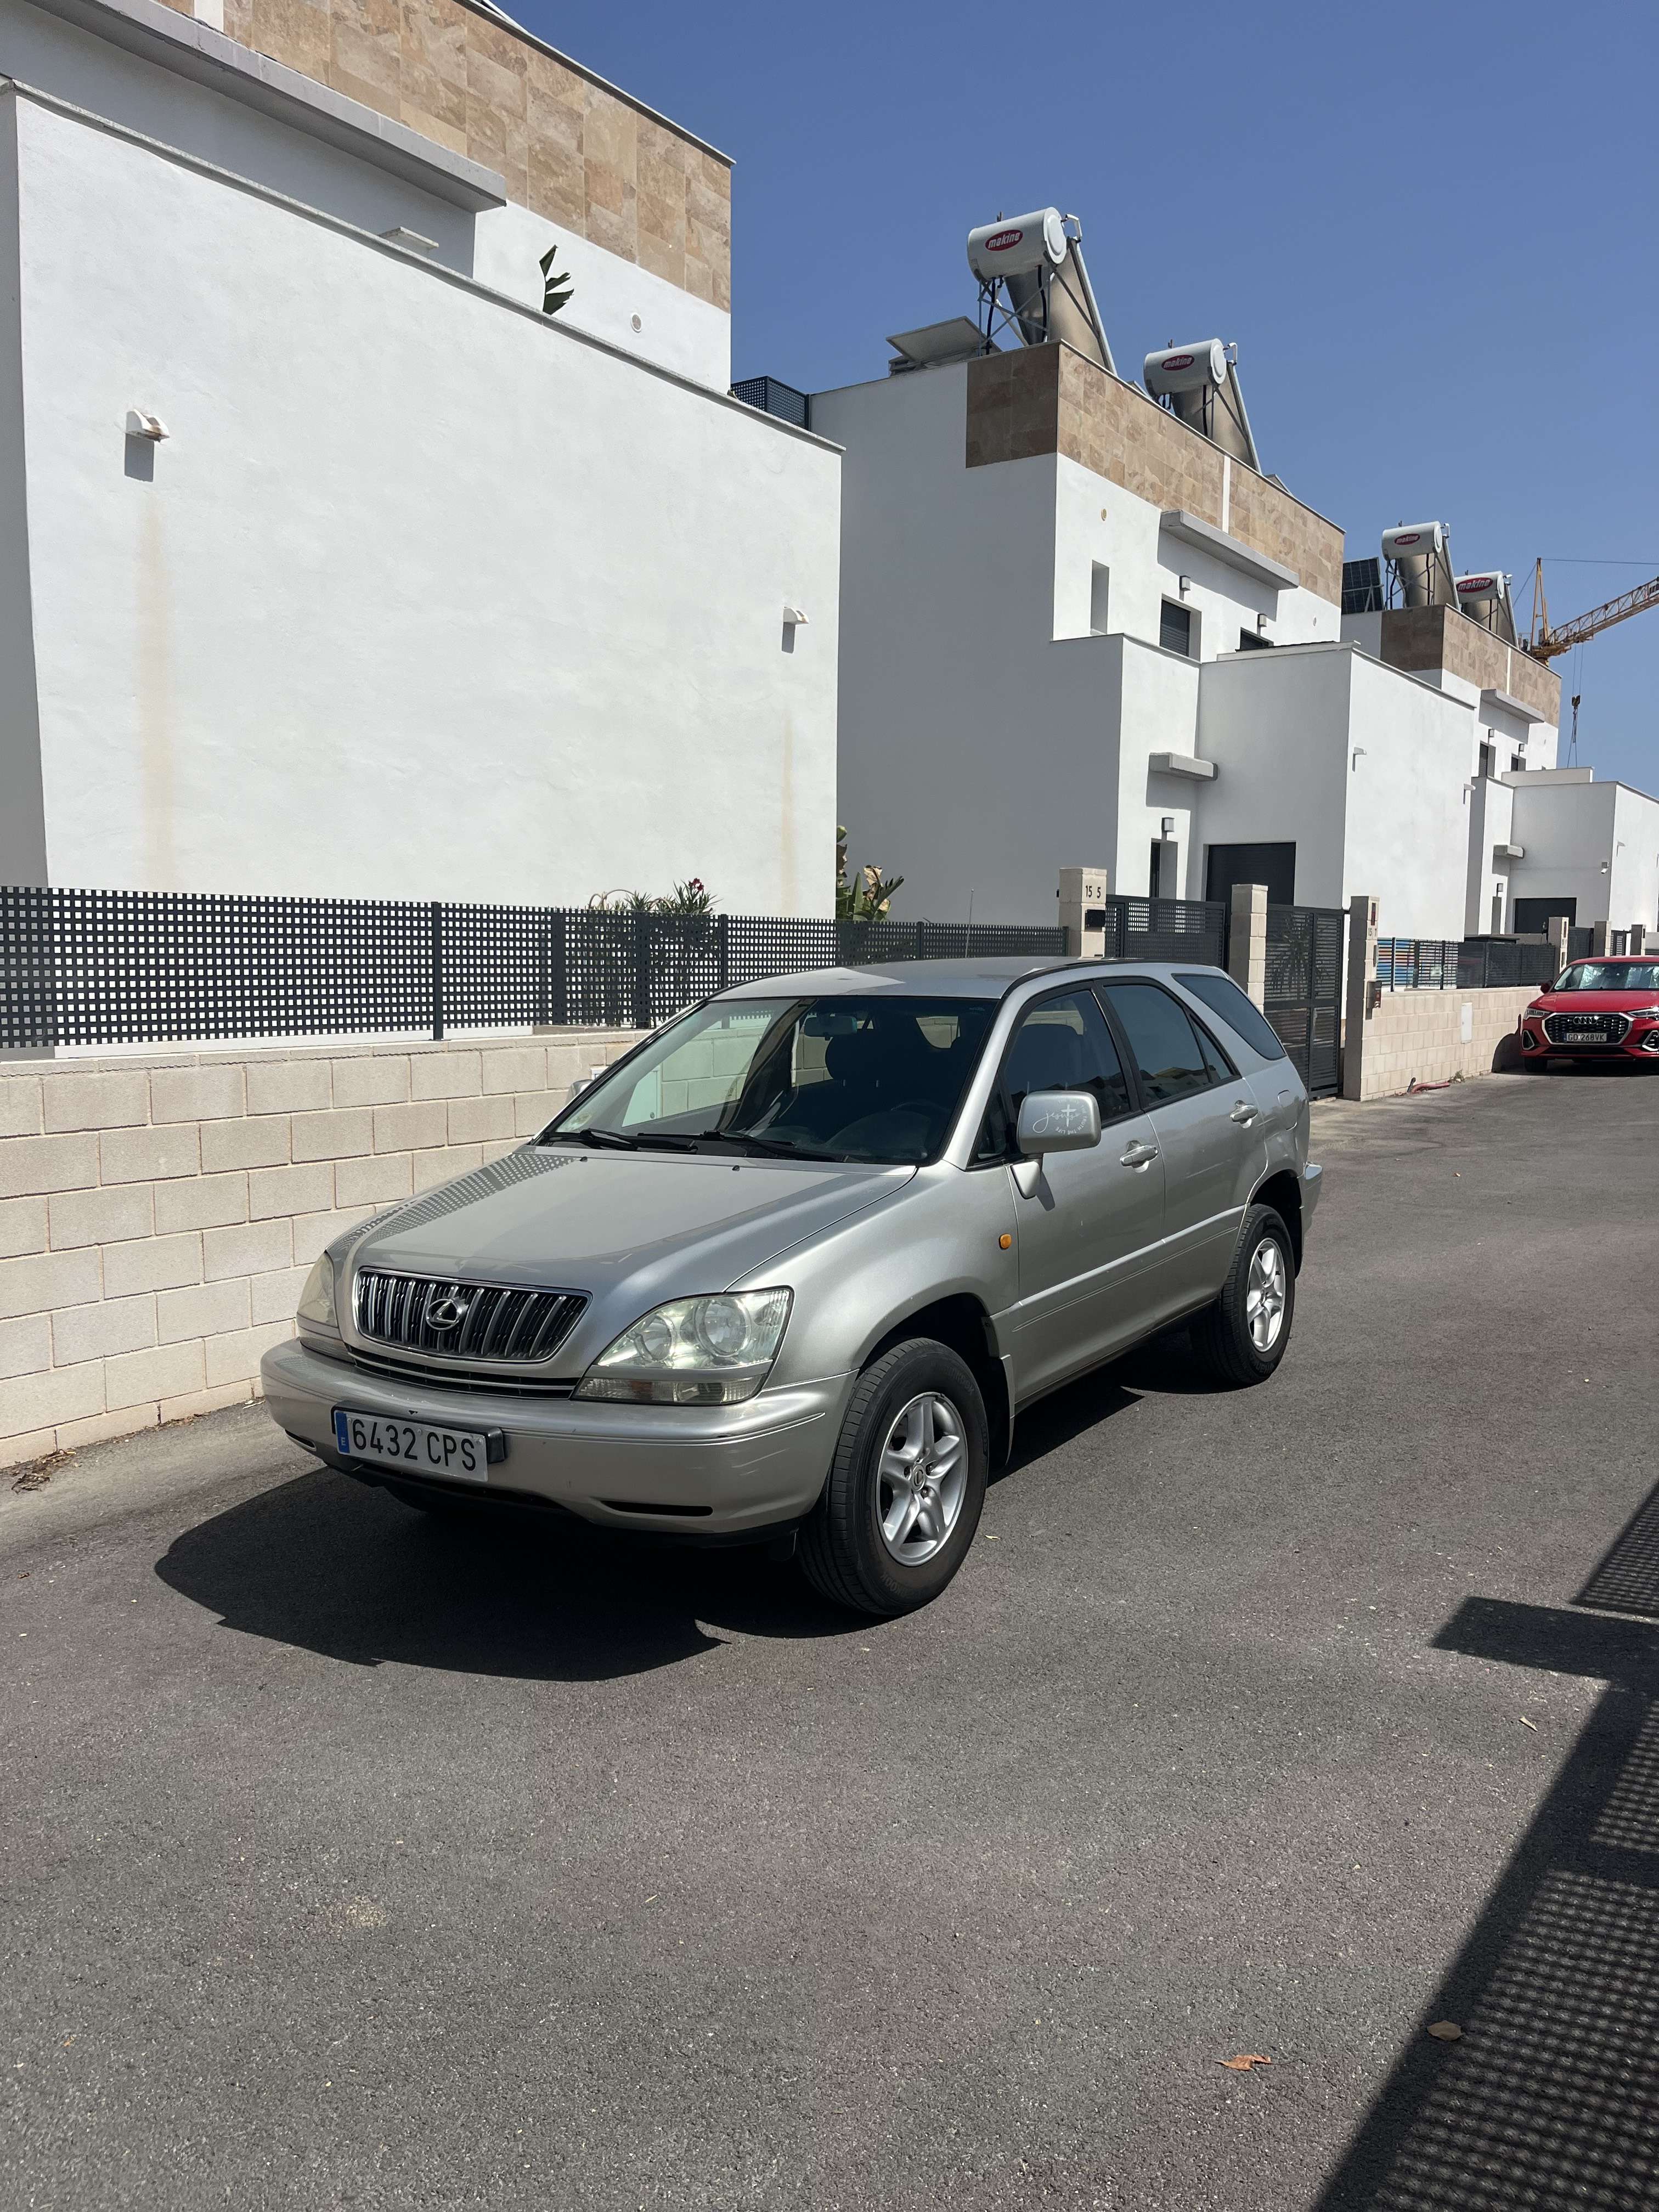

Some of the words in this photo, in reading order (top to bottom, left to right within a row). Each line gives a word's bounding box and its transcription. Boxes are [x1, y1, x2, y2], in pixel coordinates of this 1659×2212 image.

[988, 232, 1020, 249] makine
[1458, 579, 1491, 590] makine
[1085, 885, 1092, 898] 15
[1097, 887, 1101, 899] 5
[1077, 1115, 1087, 1131] TRUTH
[1055, 1126, 1066, 1135] LIFE
[340, 1437, 346, 1447] E
[352, 1419, 419, 1461] 6432
[426, 1432, 477, 1471] CPS
